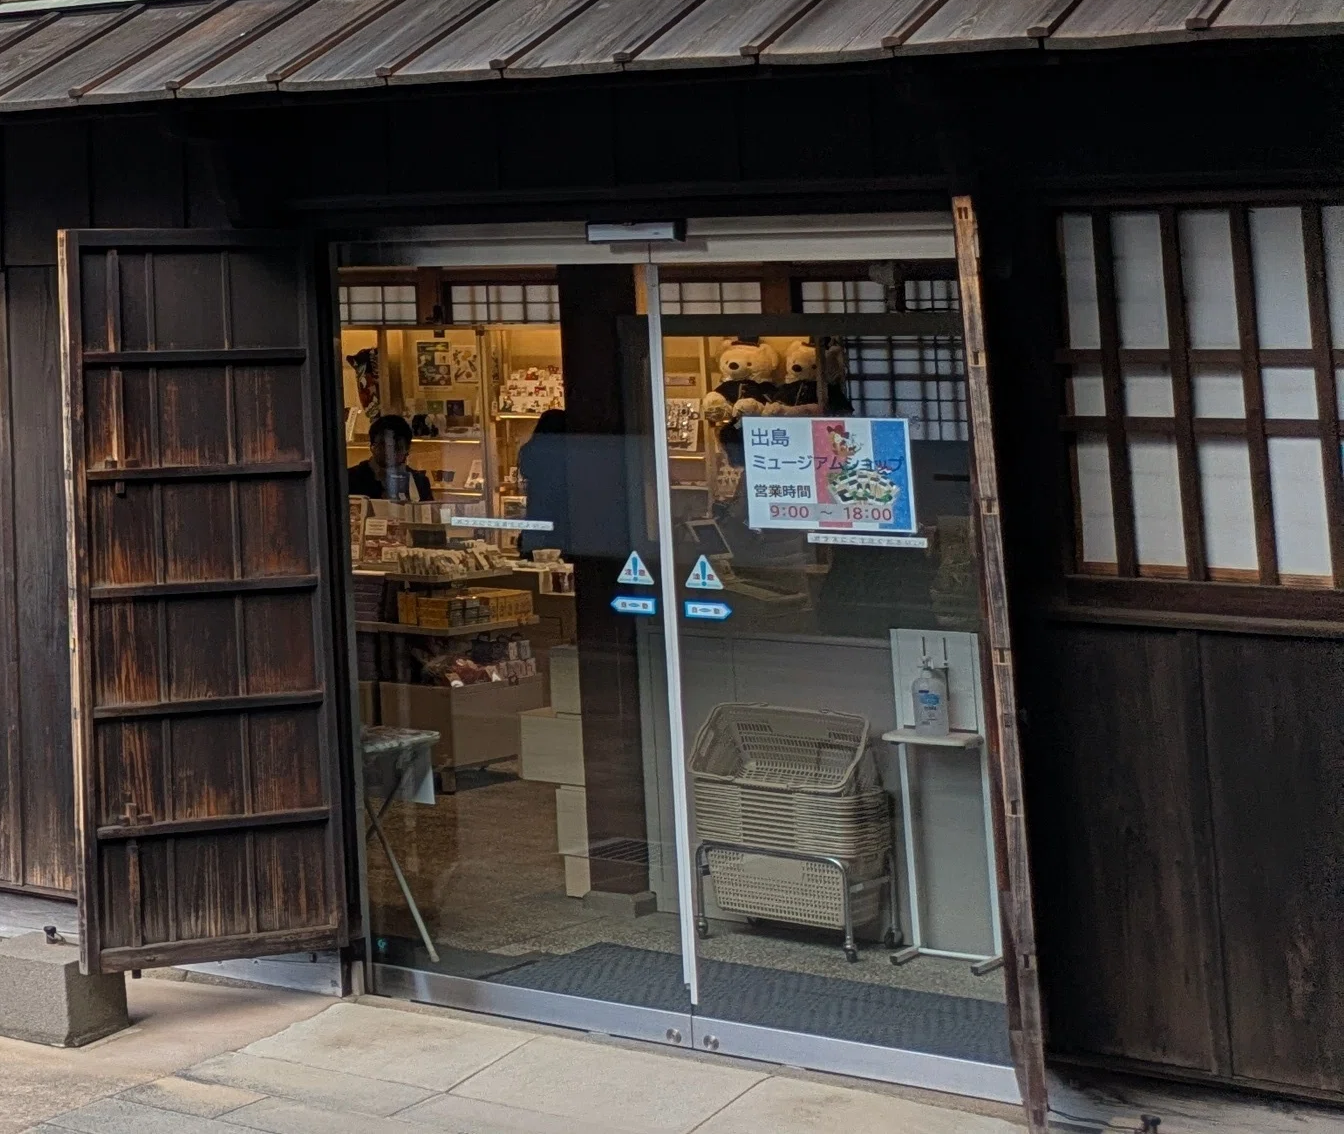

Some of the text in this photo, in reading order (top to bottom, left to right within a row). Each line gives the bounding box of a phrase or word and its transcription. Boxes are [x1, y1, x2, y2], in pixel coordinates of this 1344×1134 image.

[751, 428, 790, 447] 出島
[753, 455, 905, 472] ミュージアムショップ
[754, 484, 811, 499] 営業時間
[770, 505, 810, 519] 9:00
[843, 507, 892, 521] 18:00
